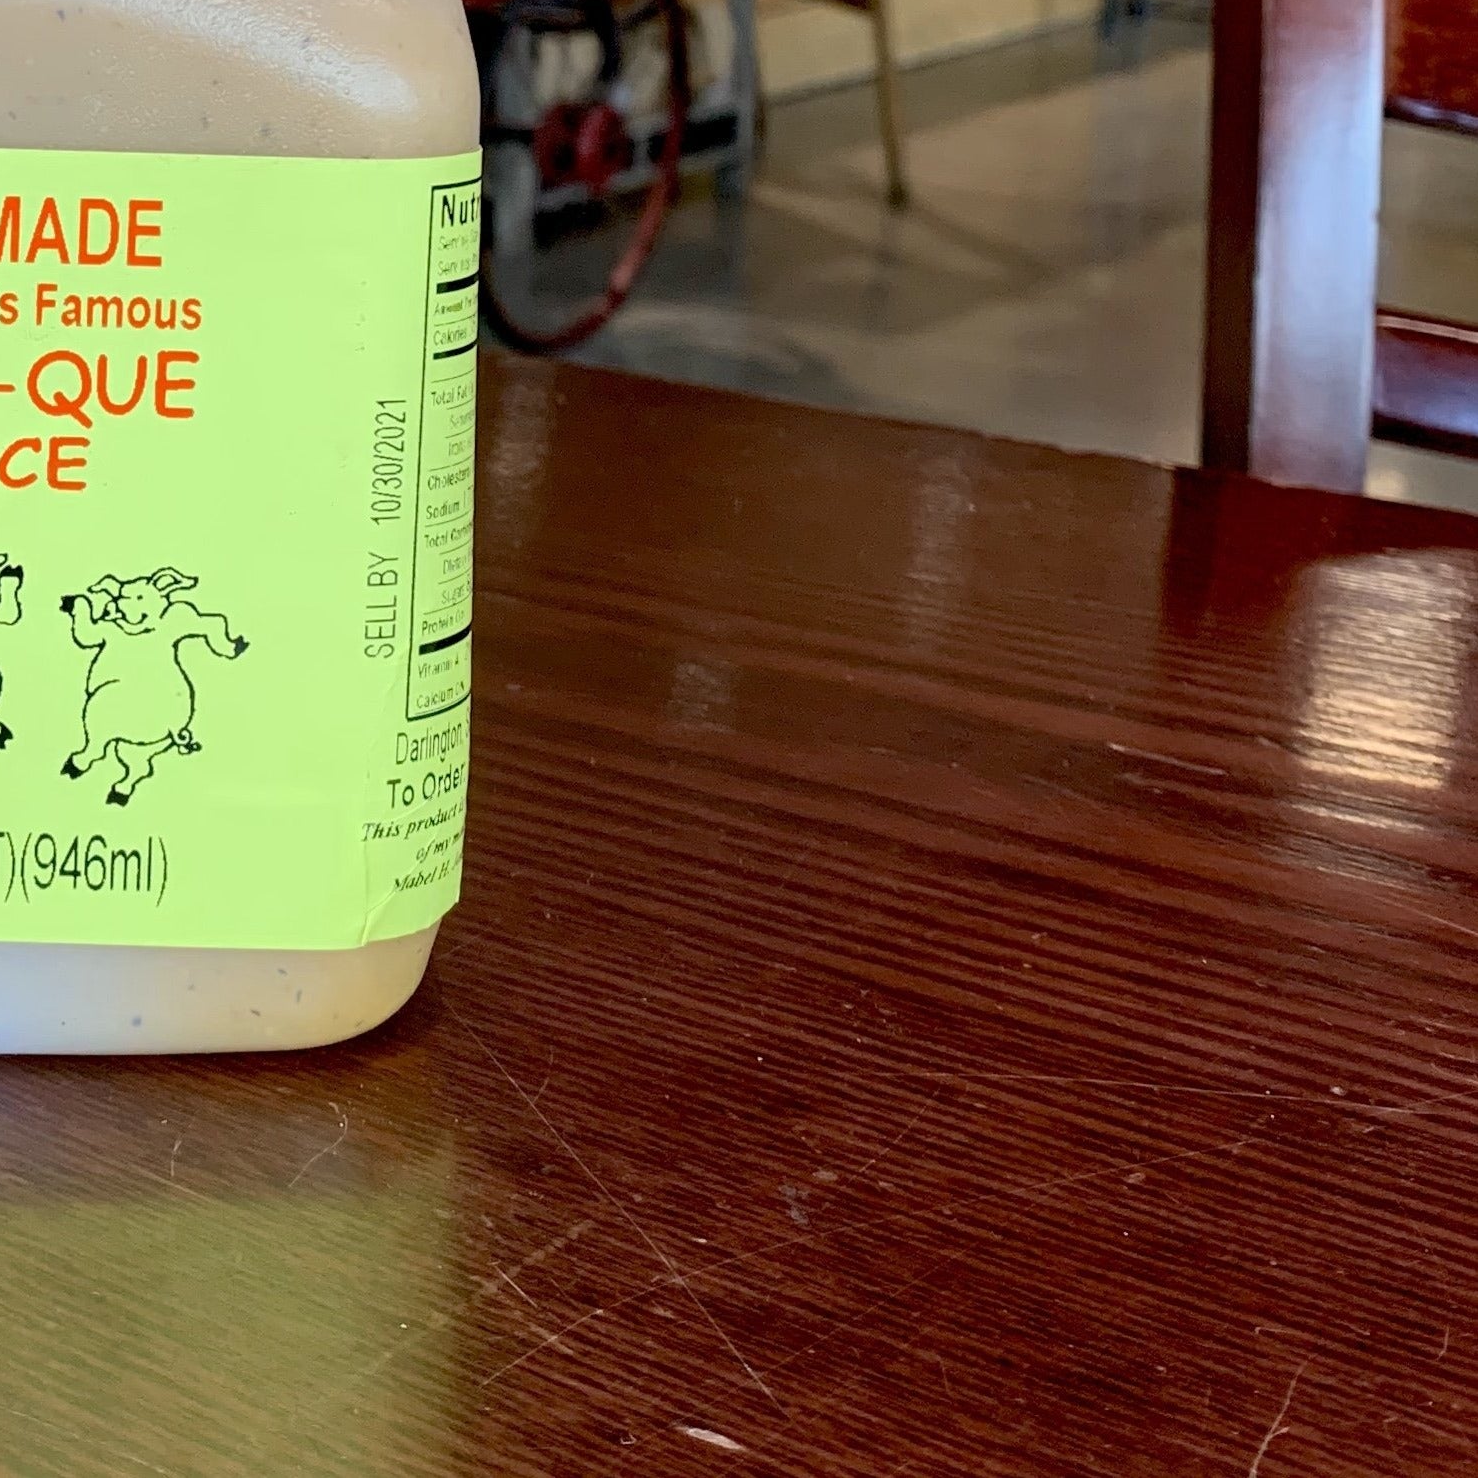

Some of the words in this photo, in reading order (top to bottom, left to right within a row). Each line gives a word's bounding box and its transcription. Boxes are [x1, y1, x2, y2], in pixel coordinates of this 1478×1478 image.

[36, 283, 203, 330] Famous
[371, 400, 406, 525] 10/30/2021
[367, 552, 399, 586] BY
[365, 595, 397, 658] SELL
[387, 778, 415, 810] To
[360, 821, 401, 843] This
[404, 802, 457, 840] product
